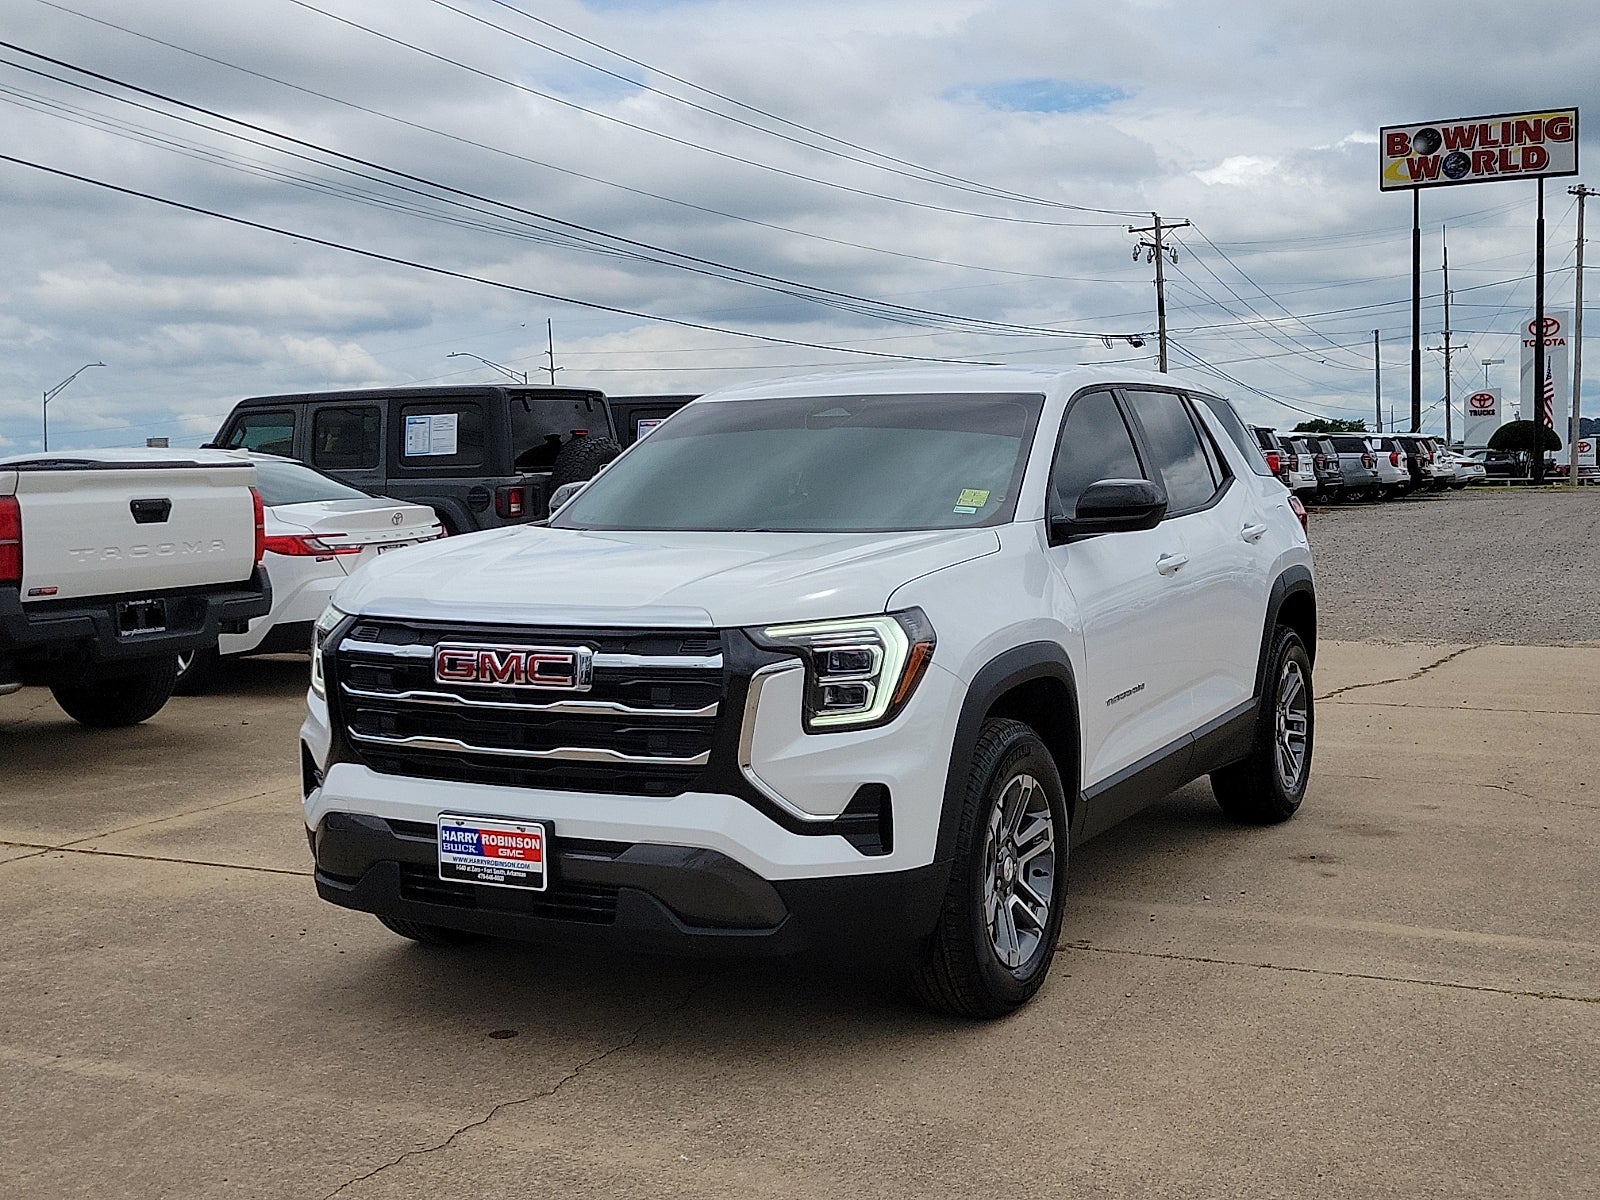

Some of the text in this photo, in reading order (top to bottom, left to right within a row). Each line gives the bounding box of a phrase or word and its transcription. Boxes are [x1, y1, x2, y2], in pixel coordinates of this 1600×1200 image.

[1386, 116, 1573, 157] BOWLING
[1406, 145, 1549, 181] WORLD
[1522, 338, 1566, 348] TOOTA
[1468, 409, 1496, 417] TRUCKS
[68, 539, 226, 562] TACOMA
[438, 650, 573, 686] GMC
[442, 830, 541, 850] HARRY ROBINSON
[442, 842, 478, 854] BUICK
[498, 848, 525, 858] GMC
